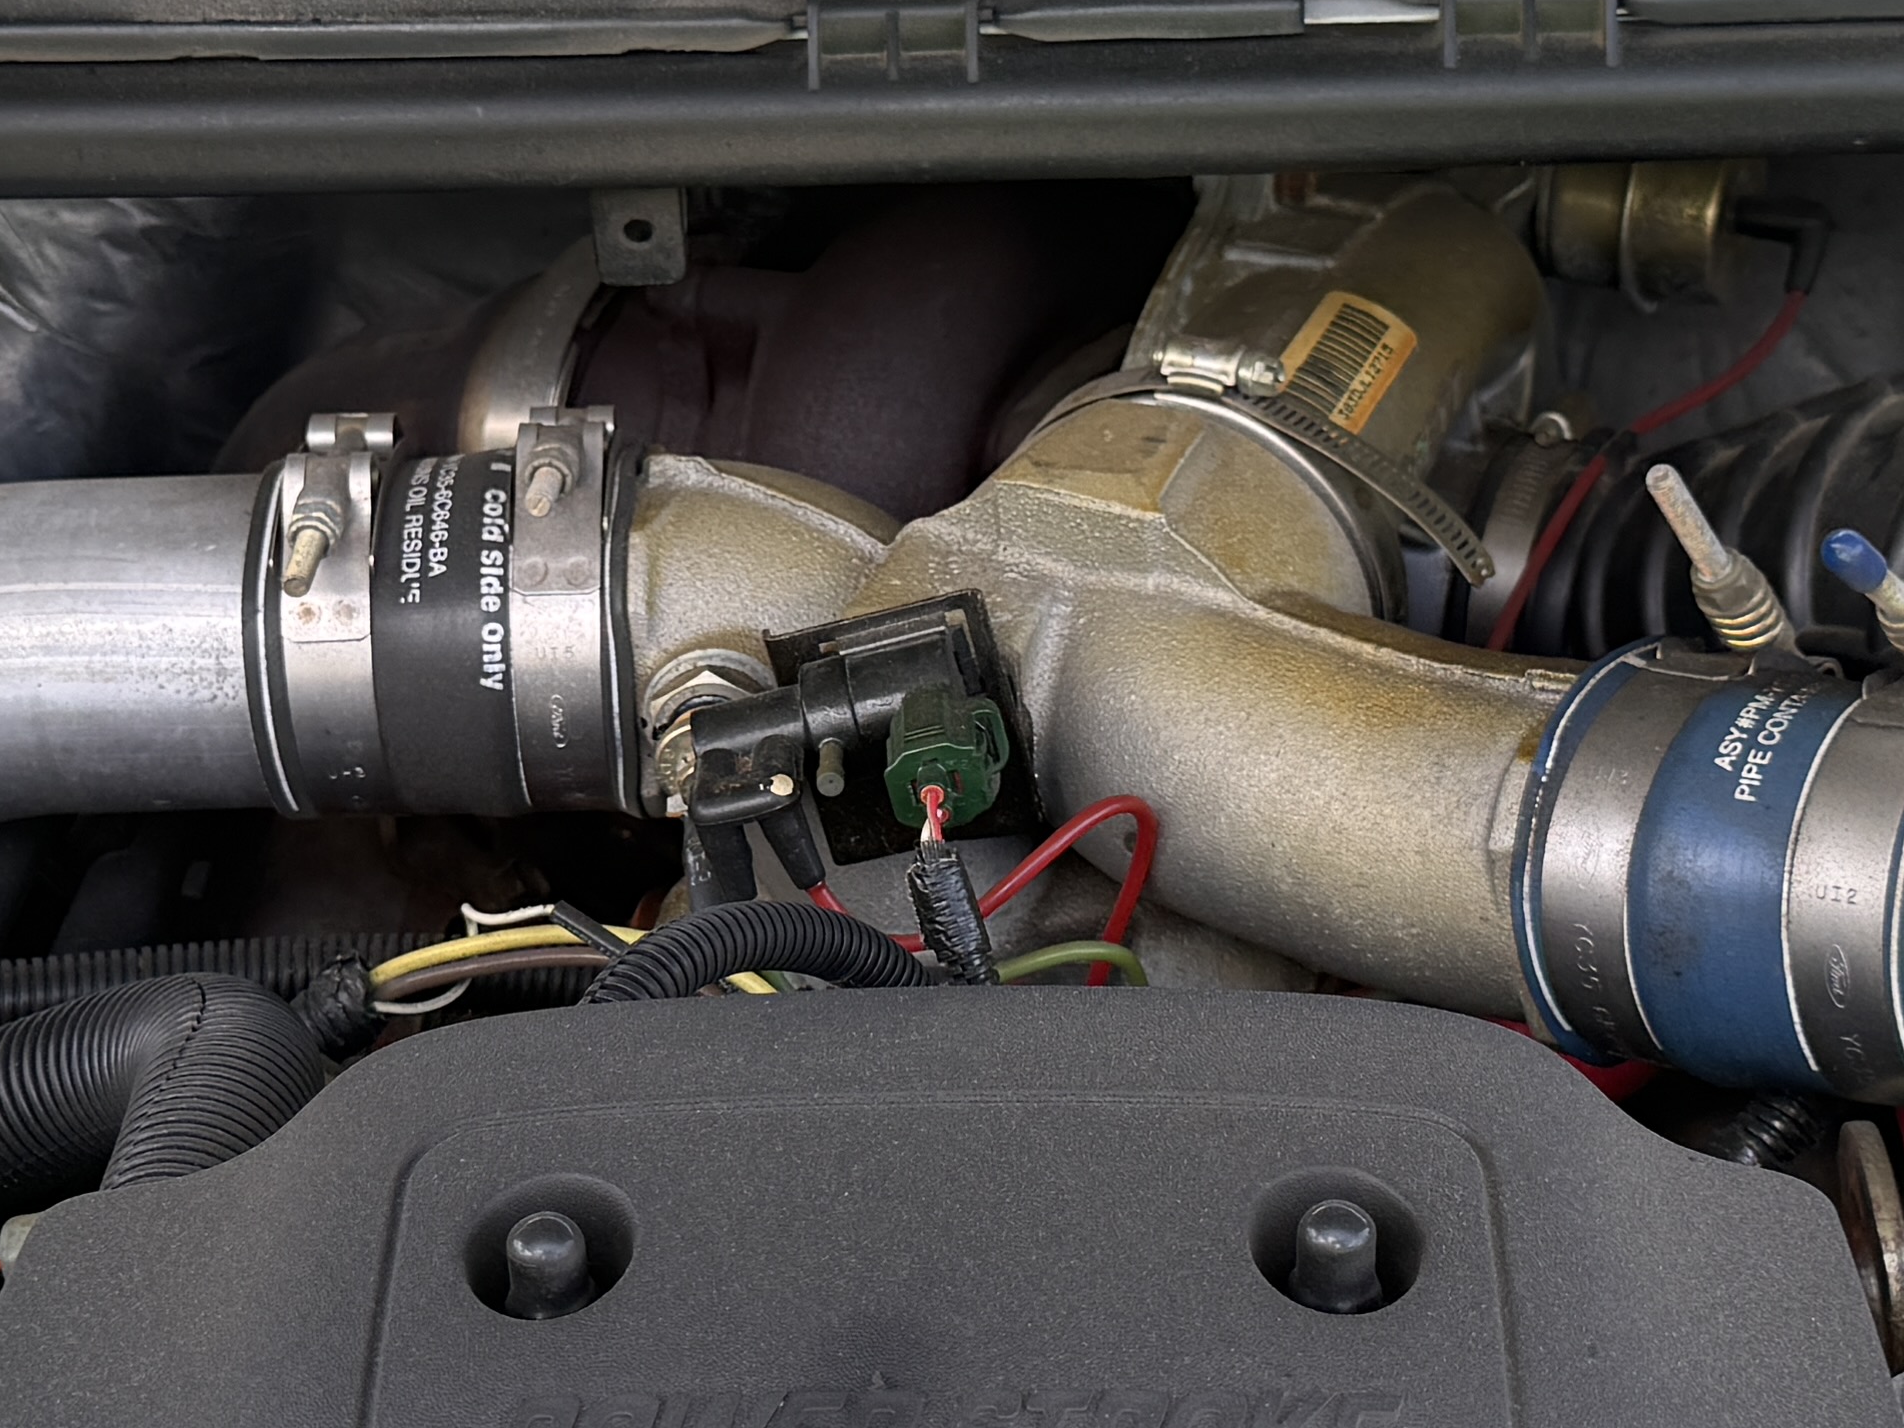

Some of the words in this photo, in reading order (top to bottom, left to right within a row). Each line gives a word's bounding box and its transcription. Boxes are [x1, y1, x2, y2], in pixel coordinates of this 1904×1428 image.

[479, 621, 505, 692] only
[1713, 726, 1750, 772] ASY
[1734, 748, 1774, 804] PIPE
